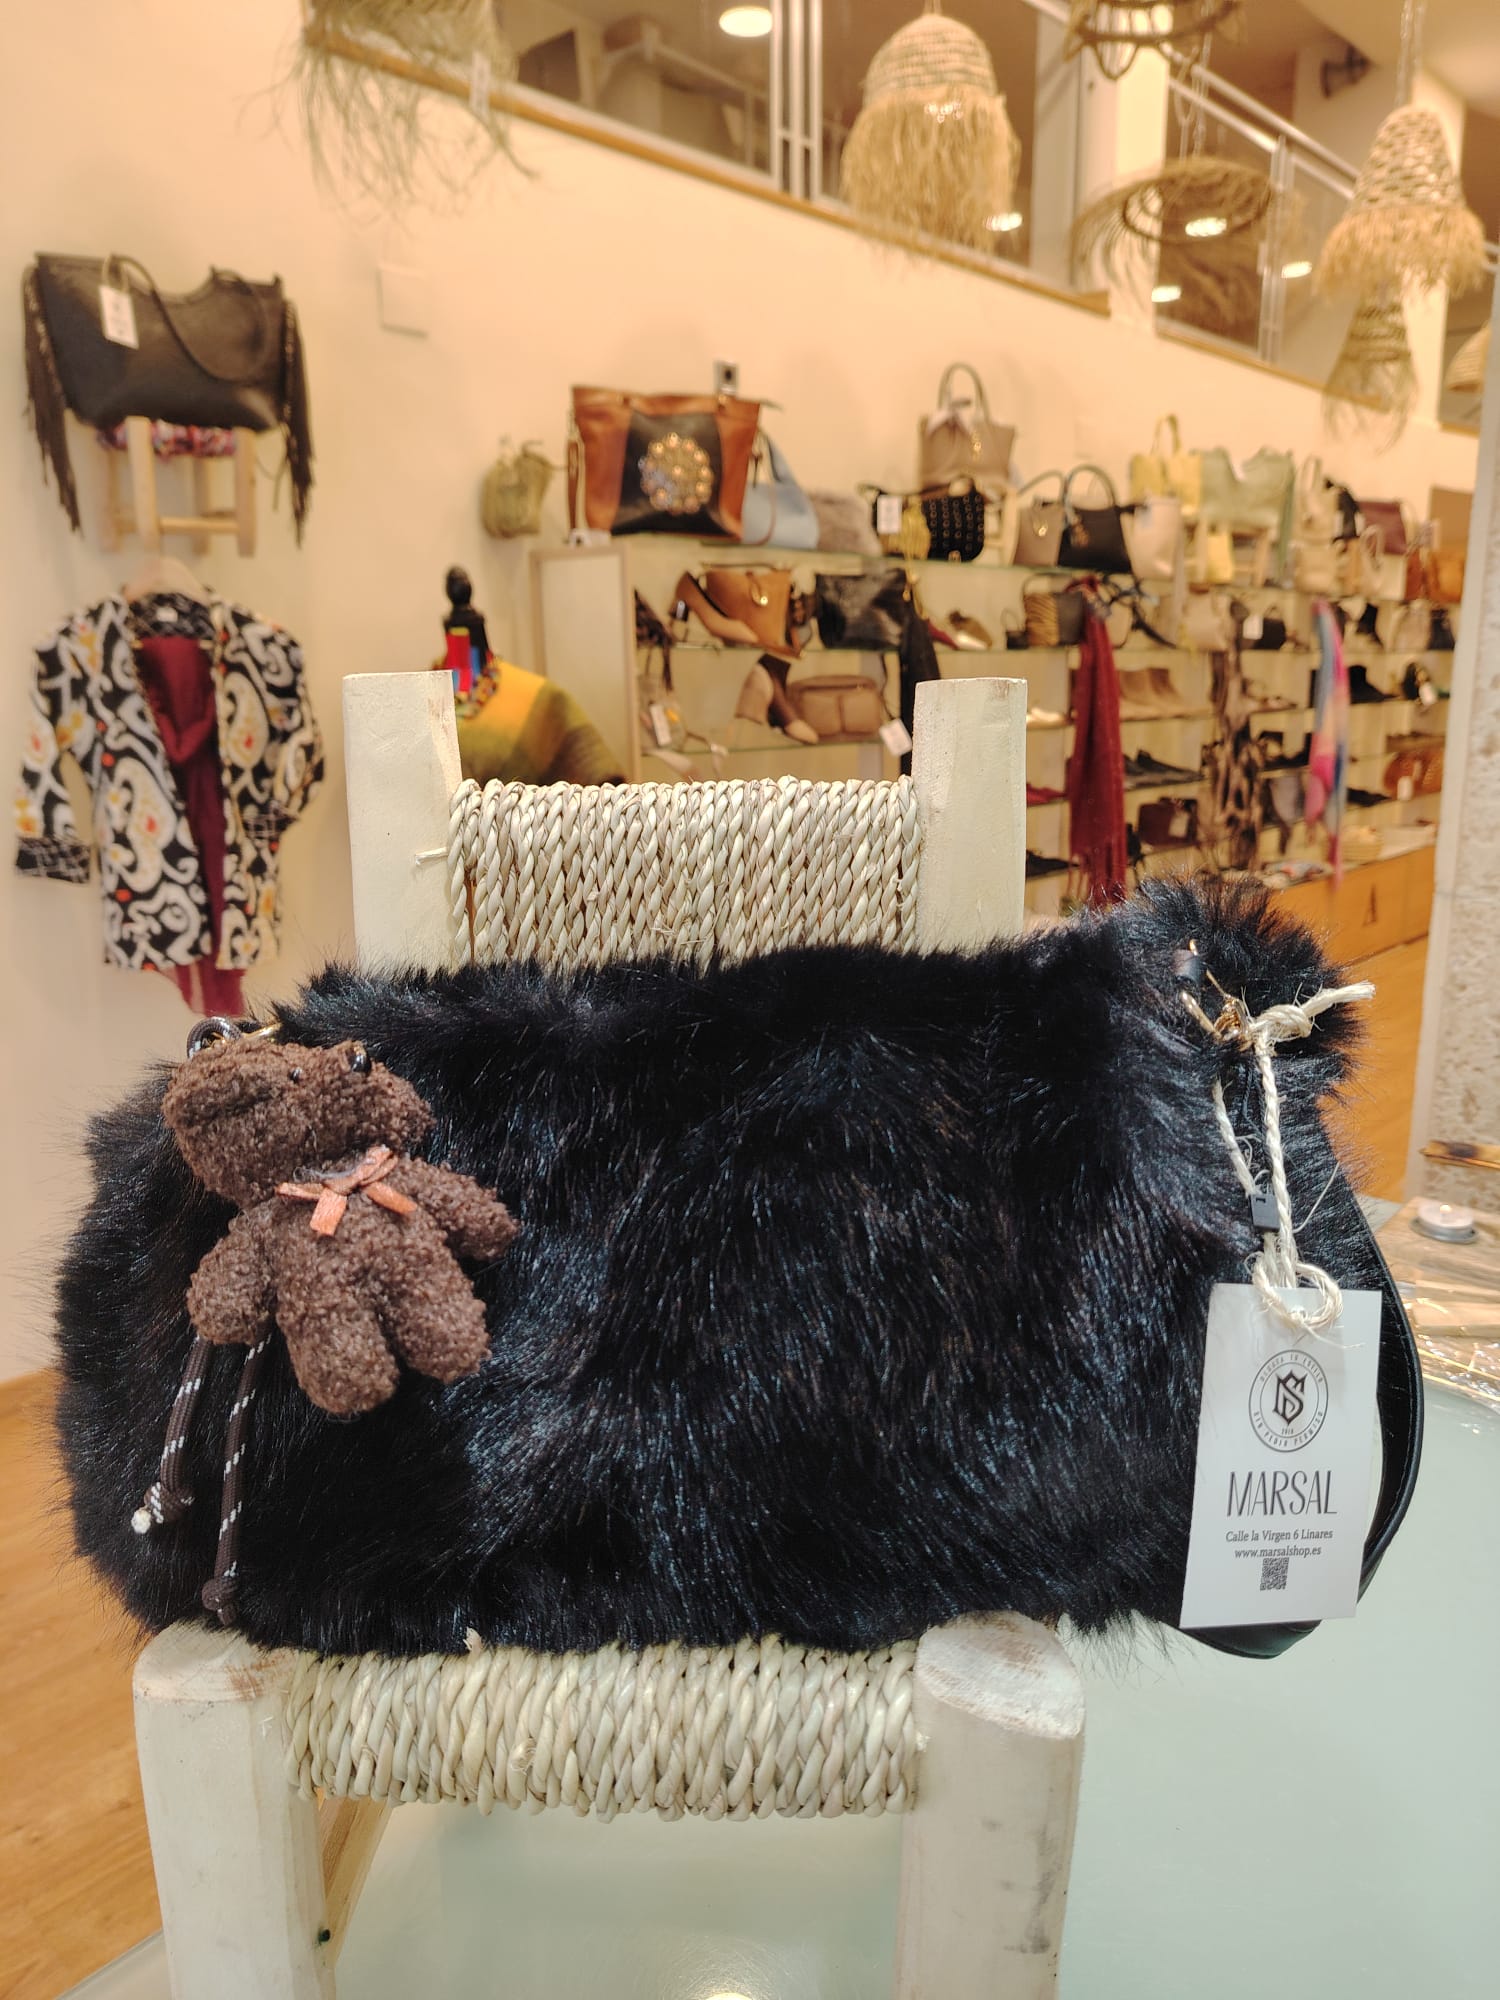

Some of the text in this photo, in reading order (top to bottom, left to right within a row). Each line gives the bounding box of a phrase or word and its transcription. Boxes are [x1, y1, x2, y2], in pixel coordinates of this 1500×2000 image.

[1226, 1470, 1337, 1517] MARSAL
[1225, 1529, 1333, 1543] Calle la Virgen 6 Linares
[1235, 1545, 1321, 1558] www.marsalshop.es
